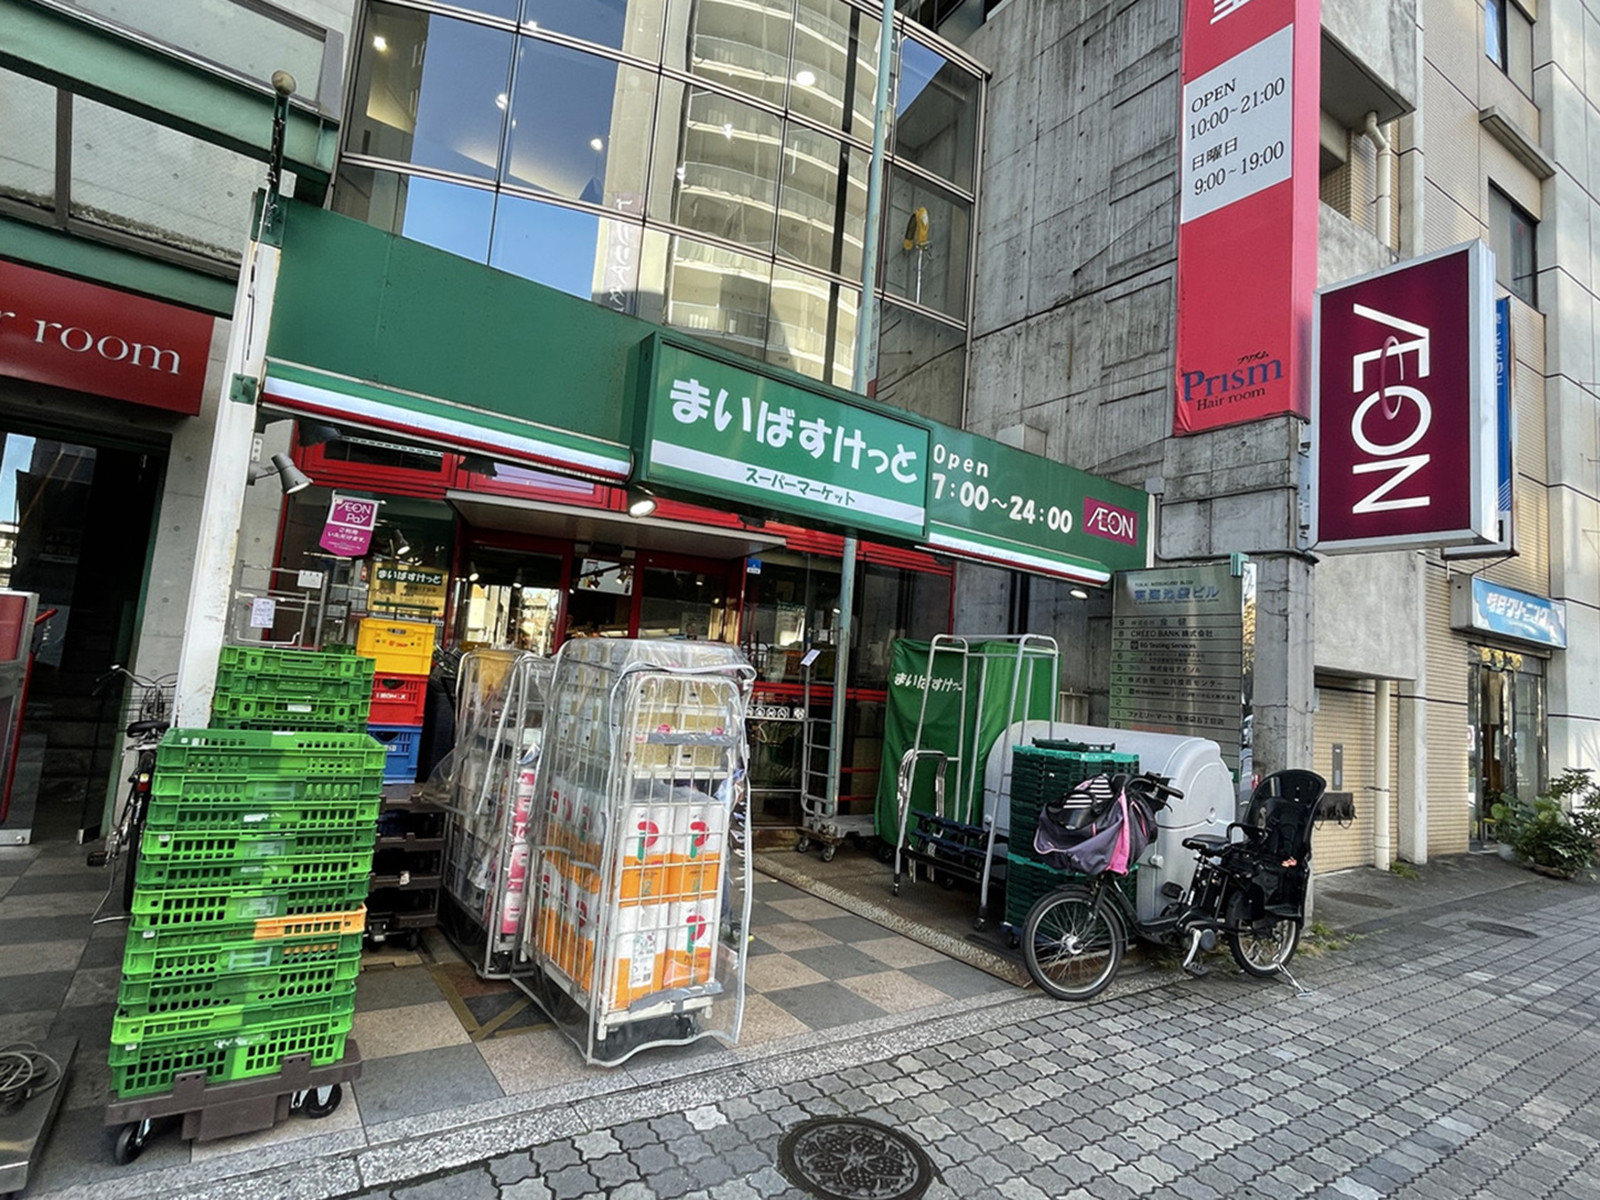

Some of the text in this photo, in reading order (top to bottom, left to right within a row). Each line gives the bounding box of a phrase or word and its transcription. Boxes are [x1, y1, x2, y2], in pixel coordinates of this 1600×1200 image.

[1191, 78, 1237, 113] OPEN
[1192, 137, 1238, 171] 日曜日
[34, 318, 182, 376] room
[1181, 359, 1283, 402] Prism
[1197, 387, 1266, 411] Hair room
[669, 377, 919, 485] まいばすけっと
[933, 443, 990, 478] Open
[745, 465, 856, 508] スーパーマーケット
